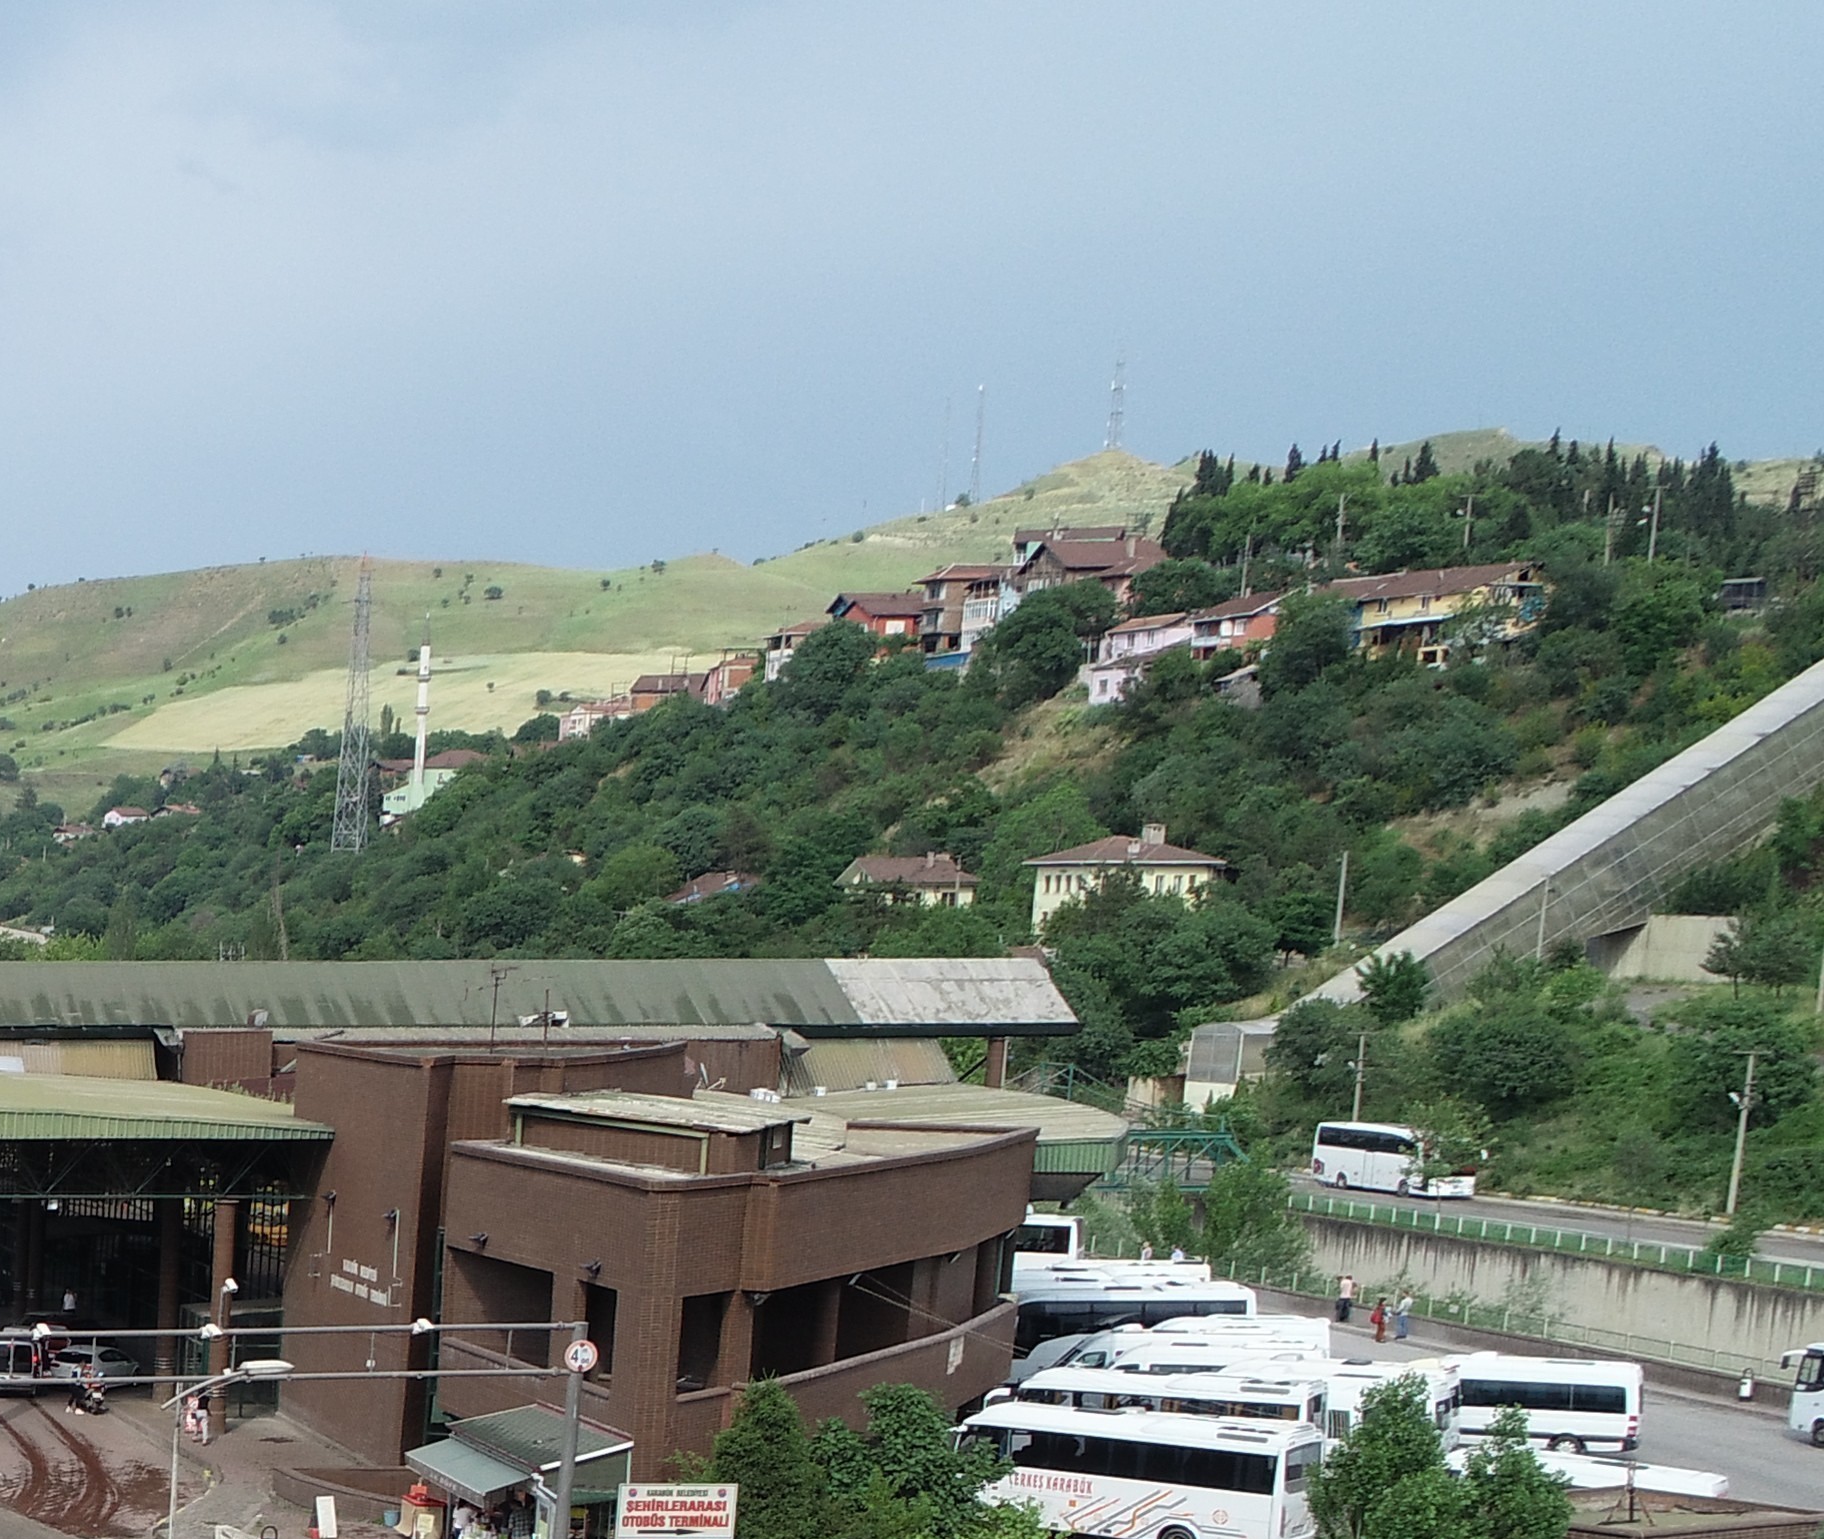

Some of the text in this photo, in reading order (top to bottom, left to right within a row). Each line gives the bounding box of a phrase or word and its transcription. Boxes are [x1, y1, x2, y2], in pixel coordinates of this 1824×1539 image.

[626, 1498, 727, 1513] ŞEHİRLERARASI
[621, 1513, 730, 1528] OTOBÜS TERMİNALİ
